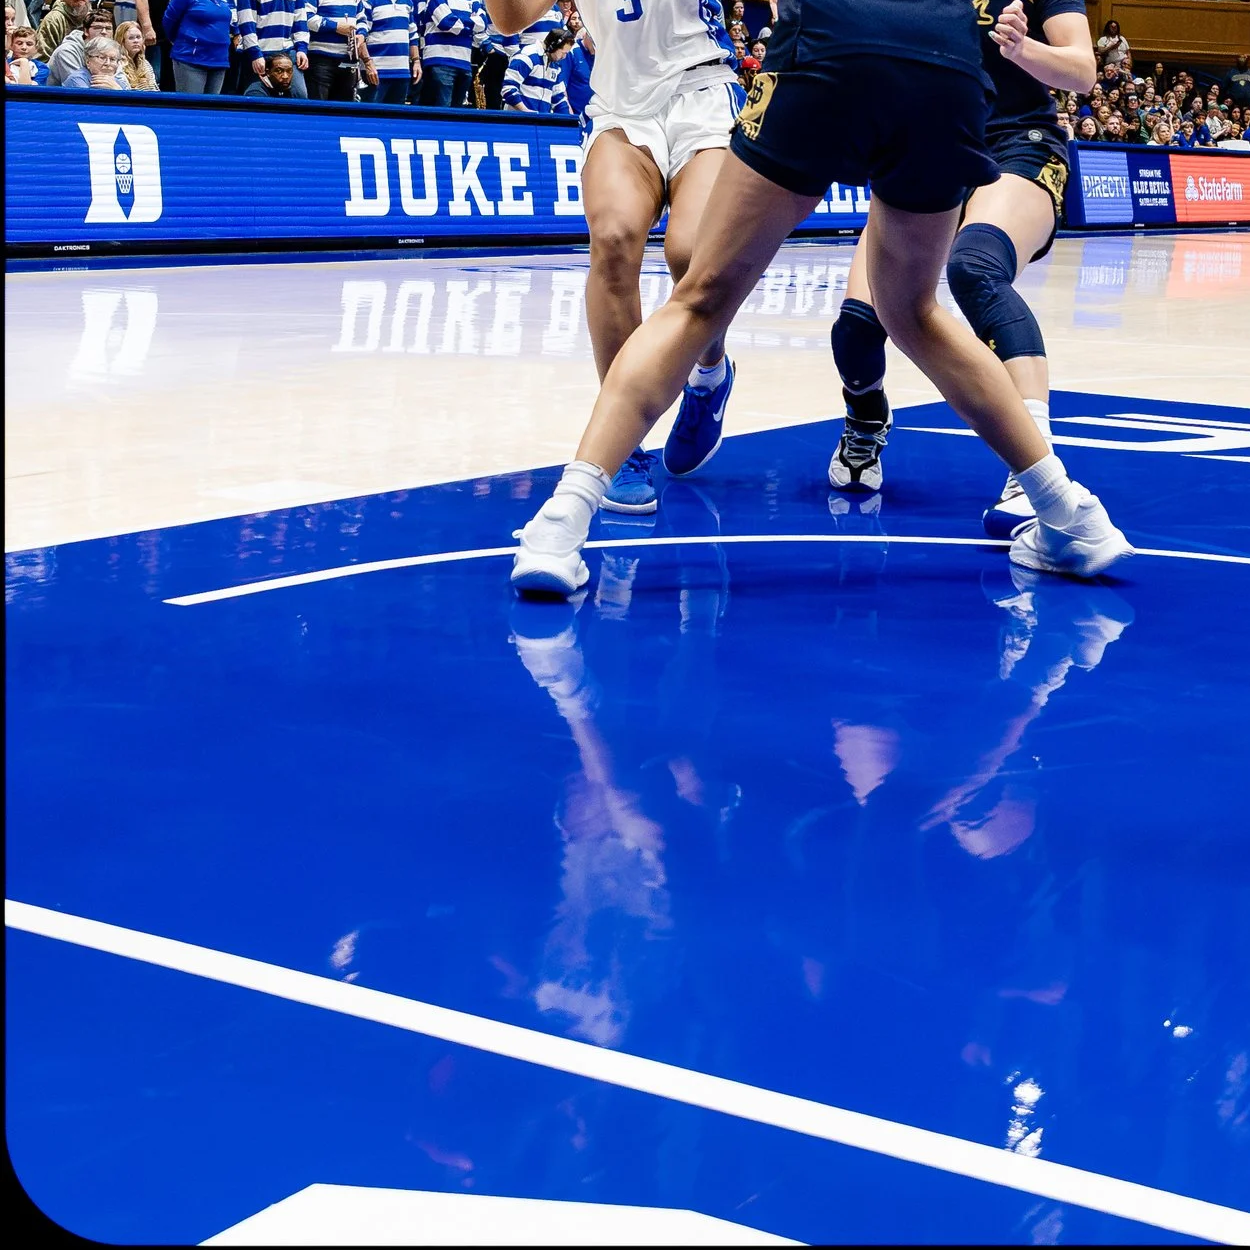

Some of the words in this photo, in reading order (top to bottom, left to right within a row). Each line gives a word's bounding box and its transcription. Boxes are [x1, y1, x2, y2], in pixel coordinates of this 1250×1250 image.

[339, 136, 535, 217] DUKE
[1139, 169, 1155, 178] STREAM
[1154, 169, 1162, 178] THE
[1083, 175, 1127, 198] DIRECTV
[1133, 180, 1148, 194] BLUE
[1150, 181, 1170, 195] DEVILS
[53, 244, 90, 252] DAKTRONICS
